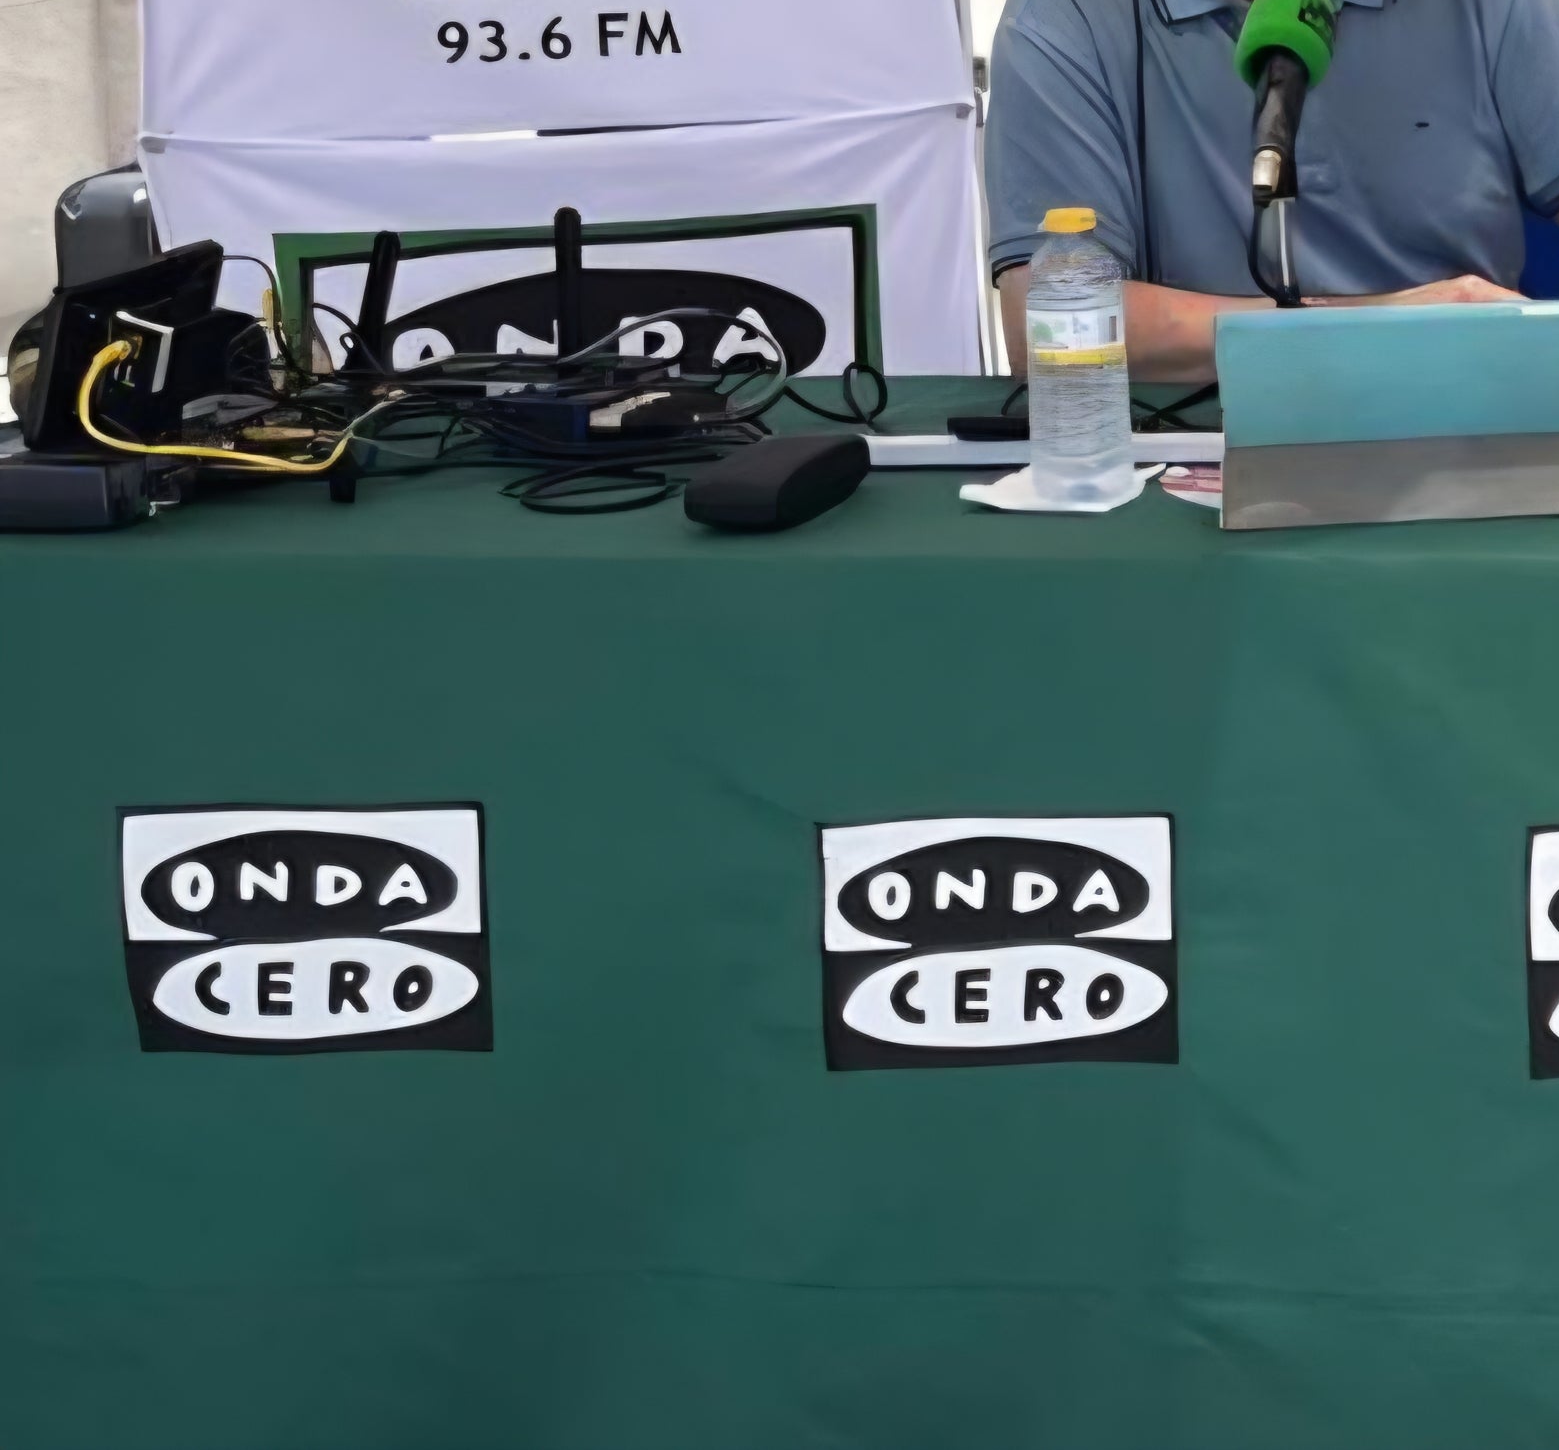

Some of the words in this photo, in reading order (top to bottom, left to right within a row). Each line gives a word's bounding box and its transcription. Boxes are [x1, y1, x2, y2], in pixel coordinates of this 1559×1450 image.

[438, 16, 571, 63] 93.6
[598, 10, 682, 57] FM
[171, 862, 428, 912] ONDA
[868, 869, 1120, 920] ONDA
[195, 961, 433, 1017] CERO
[890, 968, 1124, 1025] CERO
